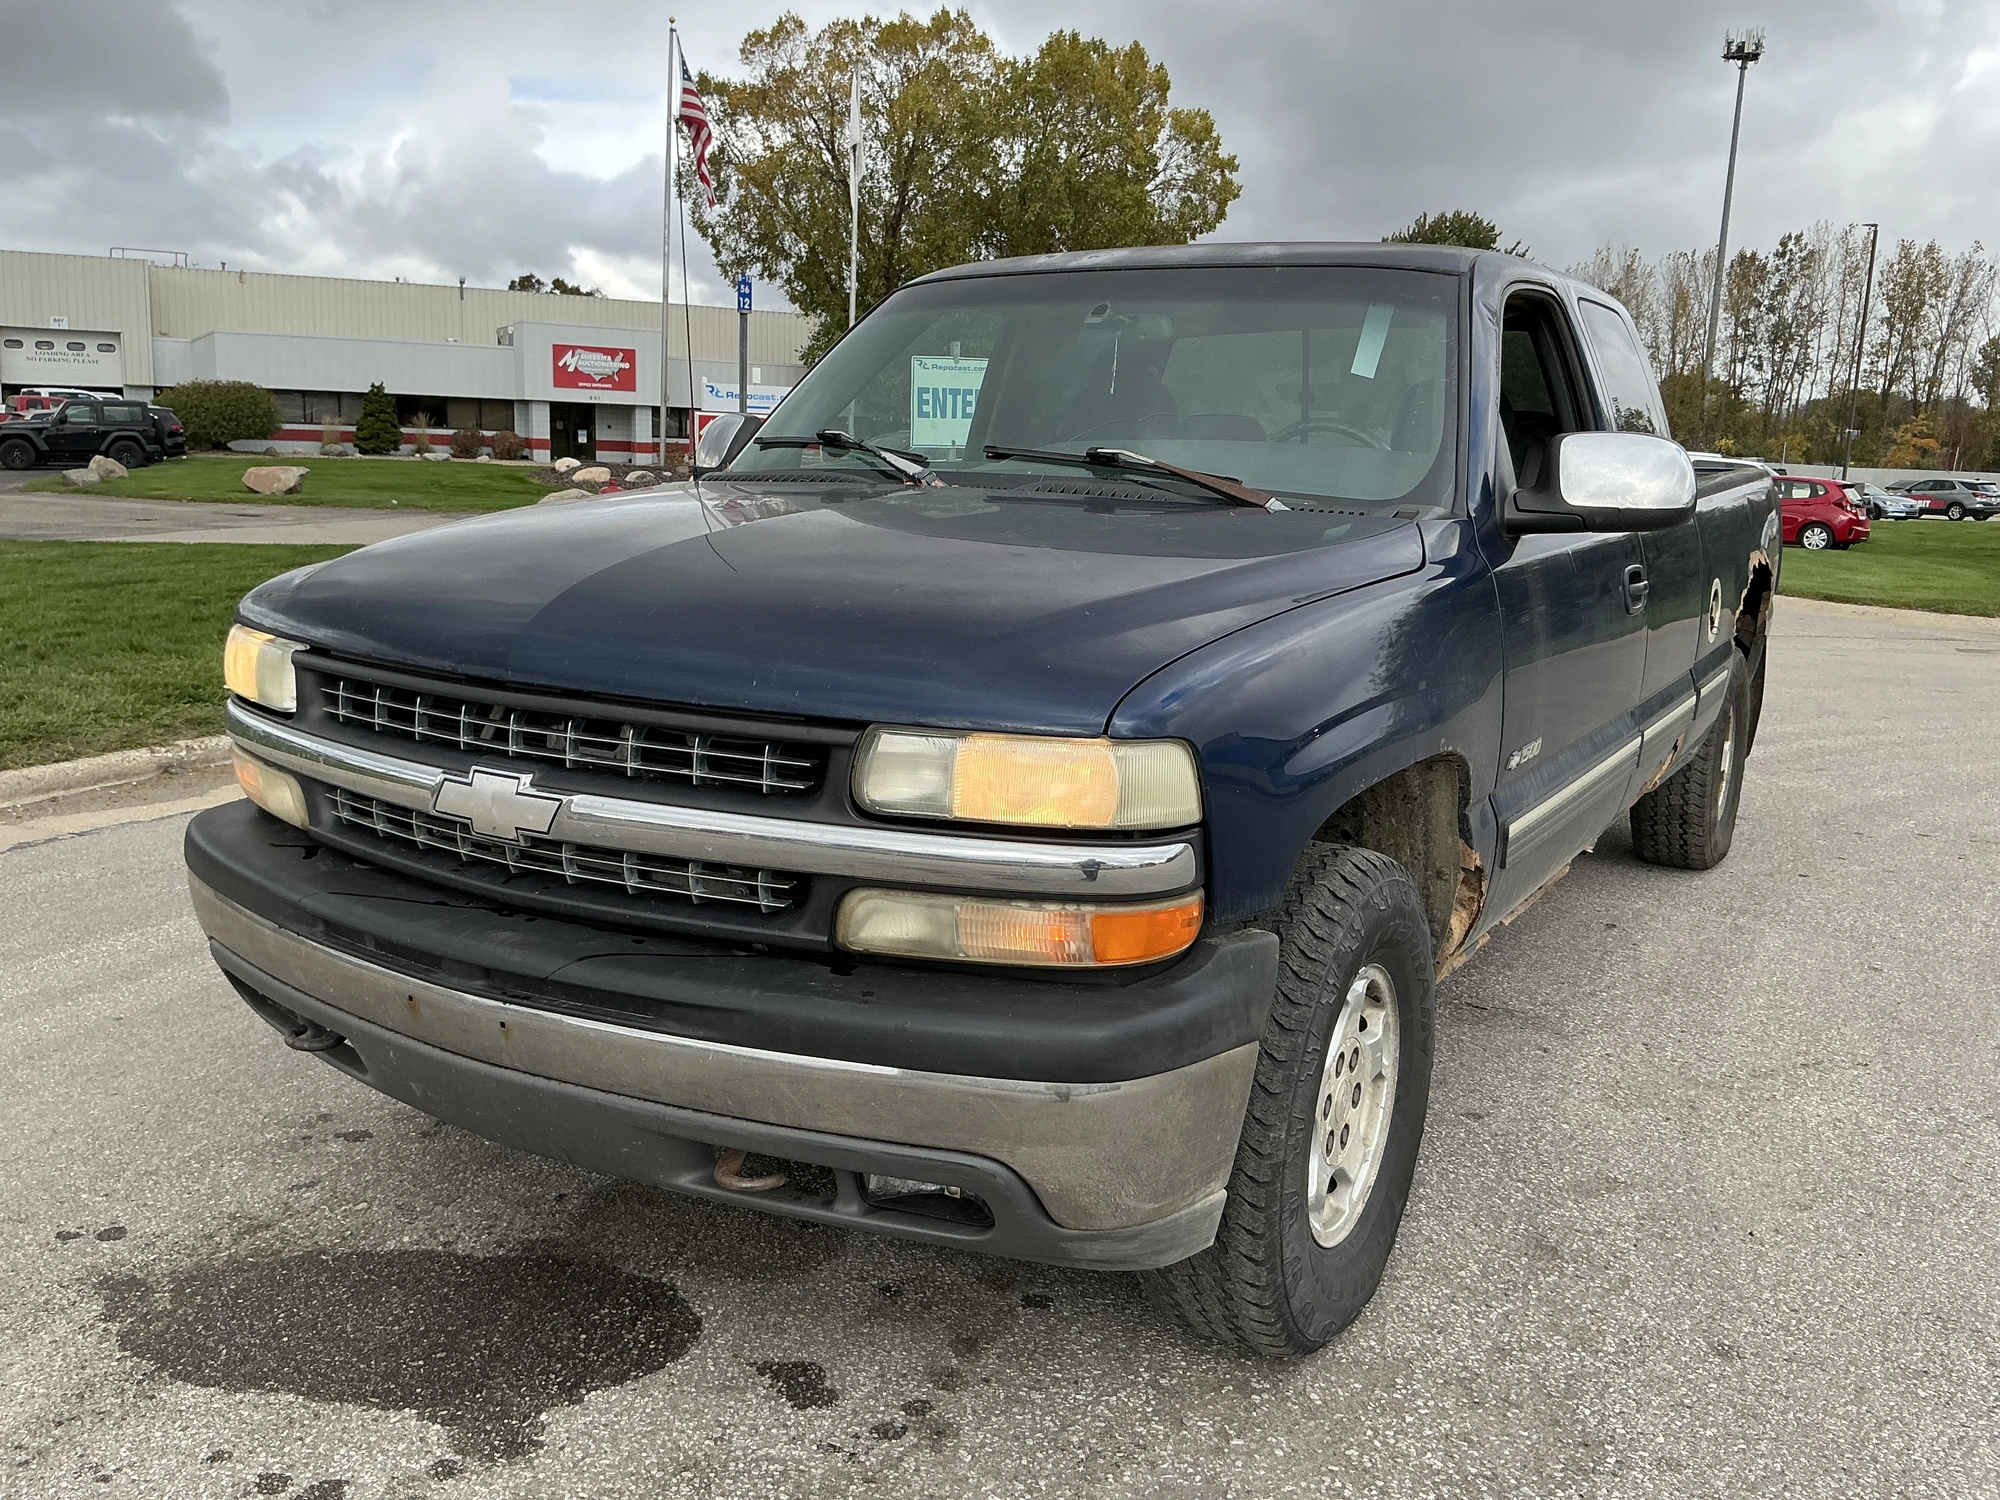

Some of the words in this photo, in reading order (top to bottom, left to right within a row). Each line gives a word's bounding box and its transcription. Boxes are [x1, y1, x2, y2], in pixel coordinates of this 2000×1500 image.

[740, 284, 750, 294] 56
[739, 296, 750, 309] 12
[580, 354, 611, 362] MIEDEMA
[578, 360, 630, 369] AUCTIONEERING
[726, 391, 785, 401] Reocast.c
